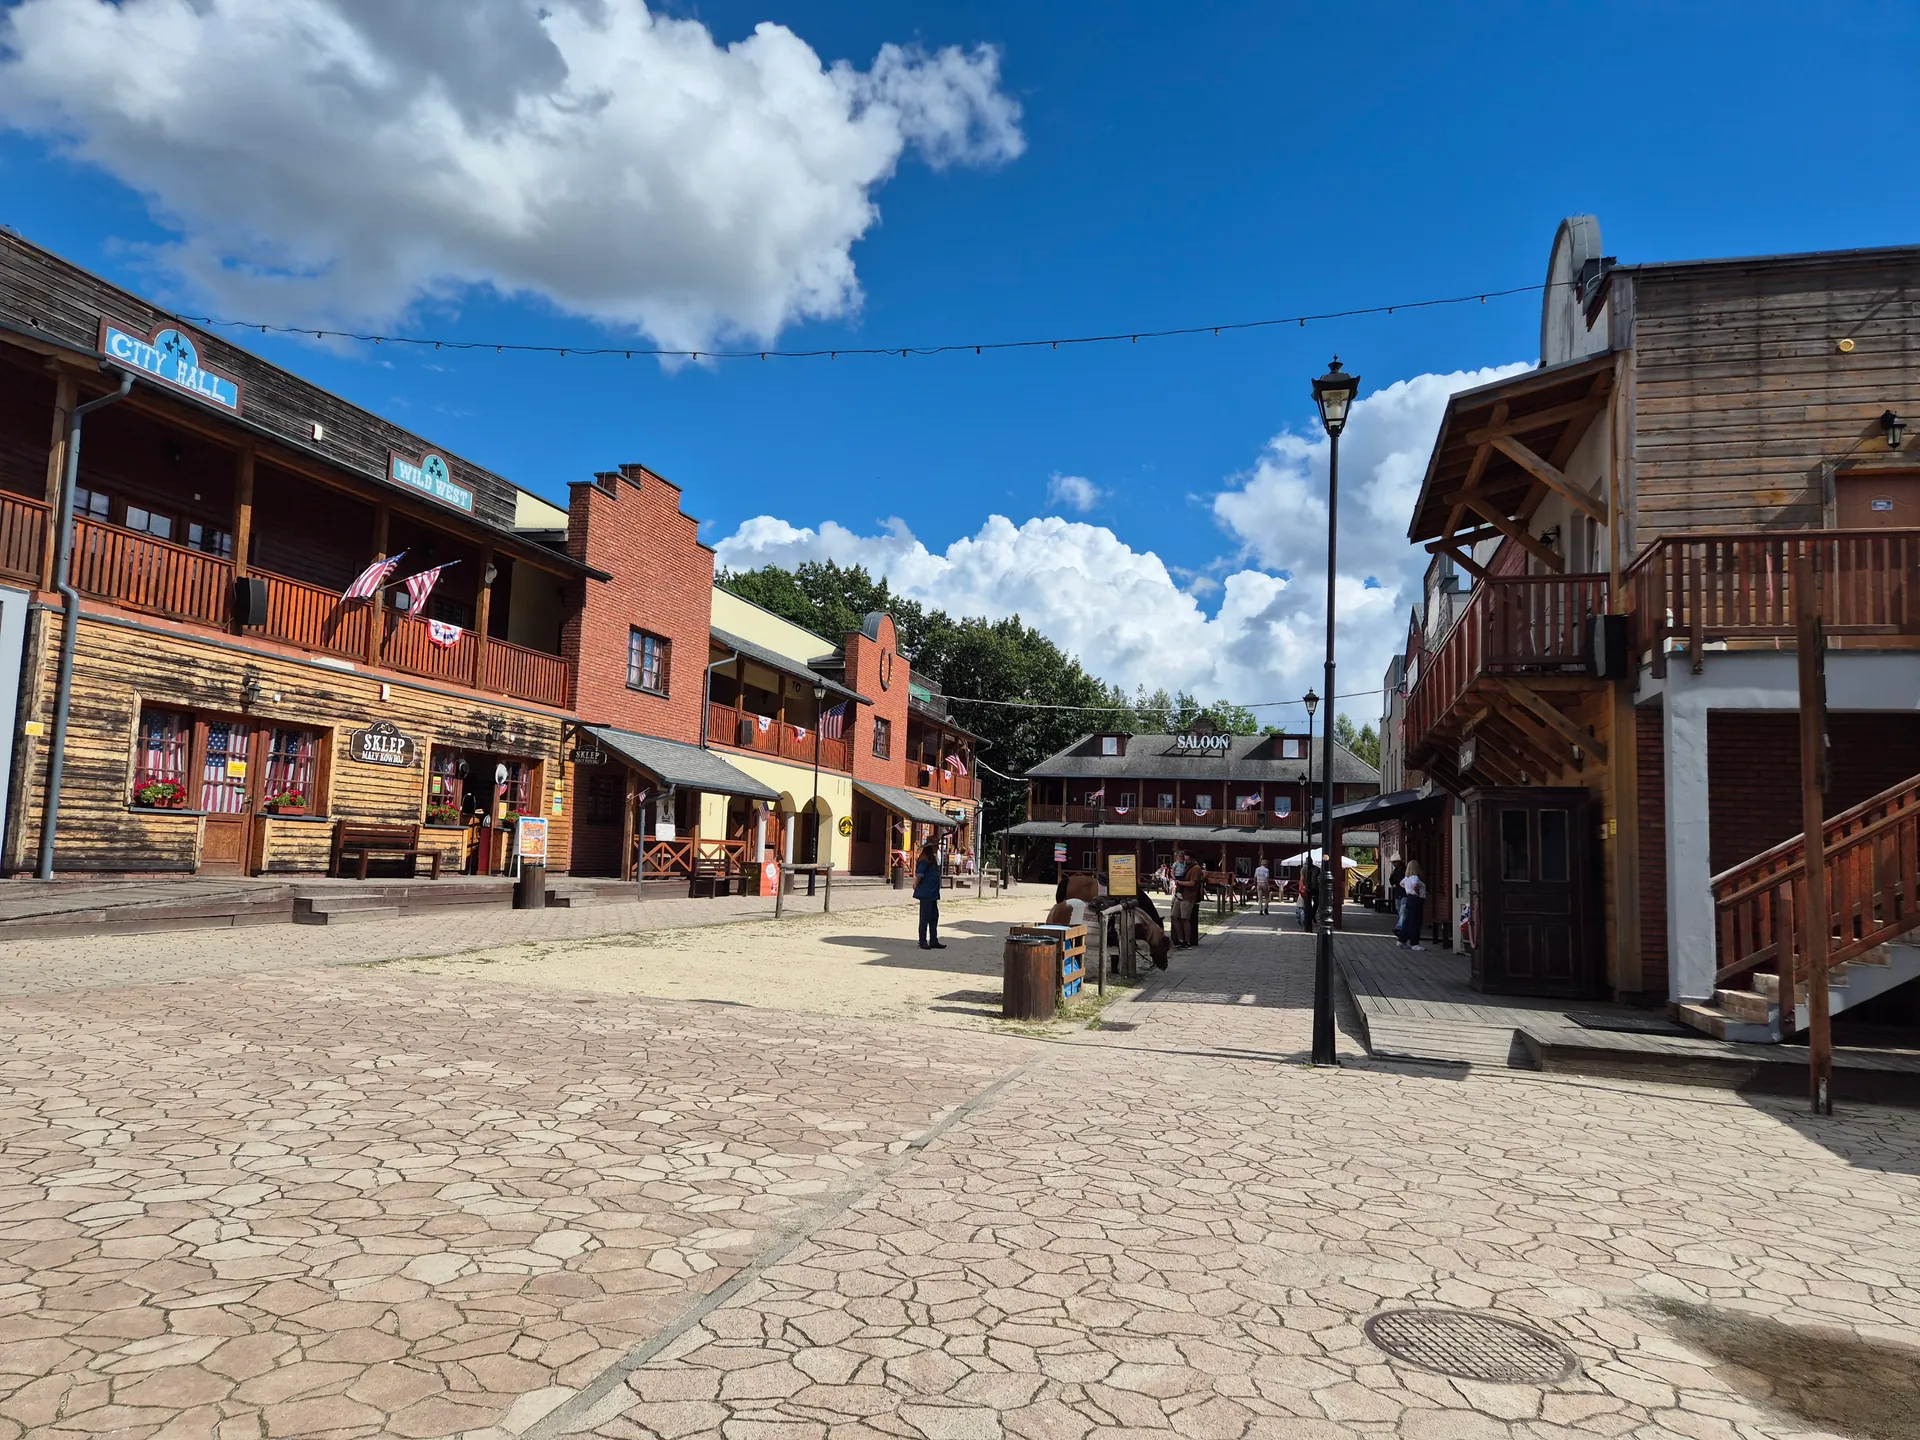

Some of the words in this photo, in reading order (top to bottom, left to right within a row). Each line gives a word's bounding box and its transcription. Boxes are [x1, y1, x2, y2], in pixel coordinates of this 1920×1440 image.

[112, 334, 167, 374] CITY
[176, 360, 226, 402] HALL
[399, 461, 432, 490] WILD
[435, 478, 468, 507] WEST
[364, 733, 406, 754] SKLEP
[1177, 733, 1231, 750] SALOON
[575, 750, 600, 760] SKLEP
